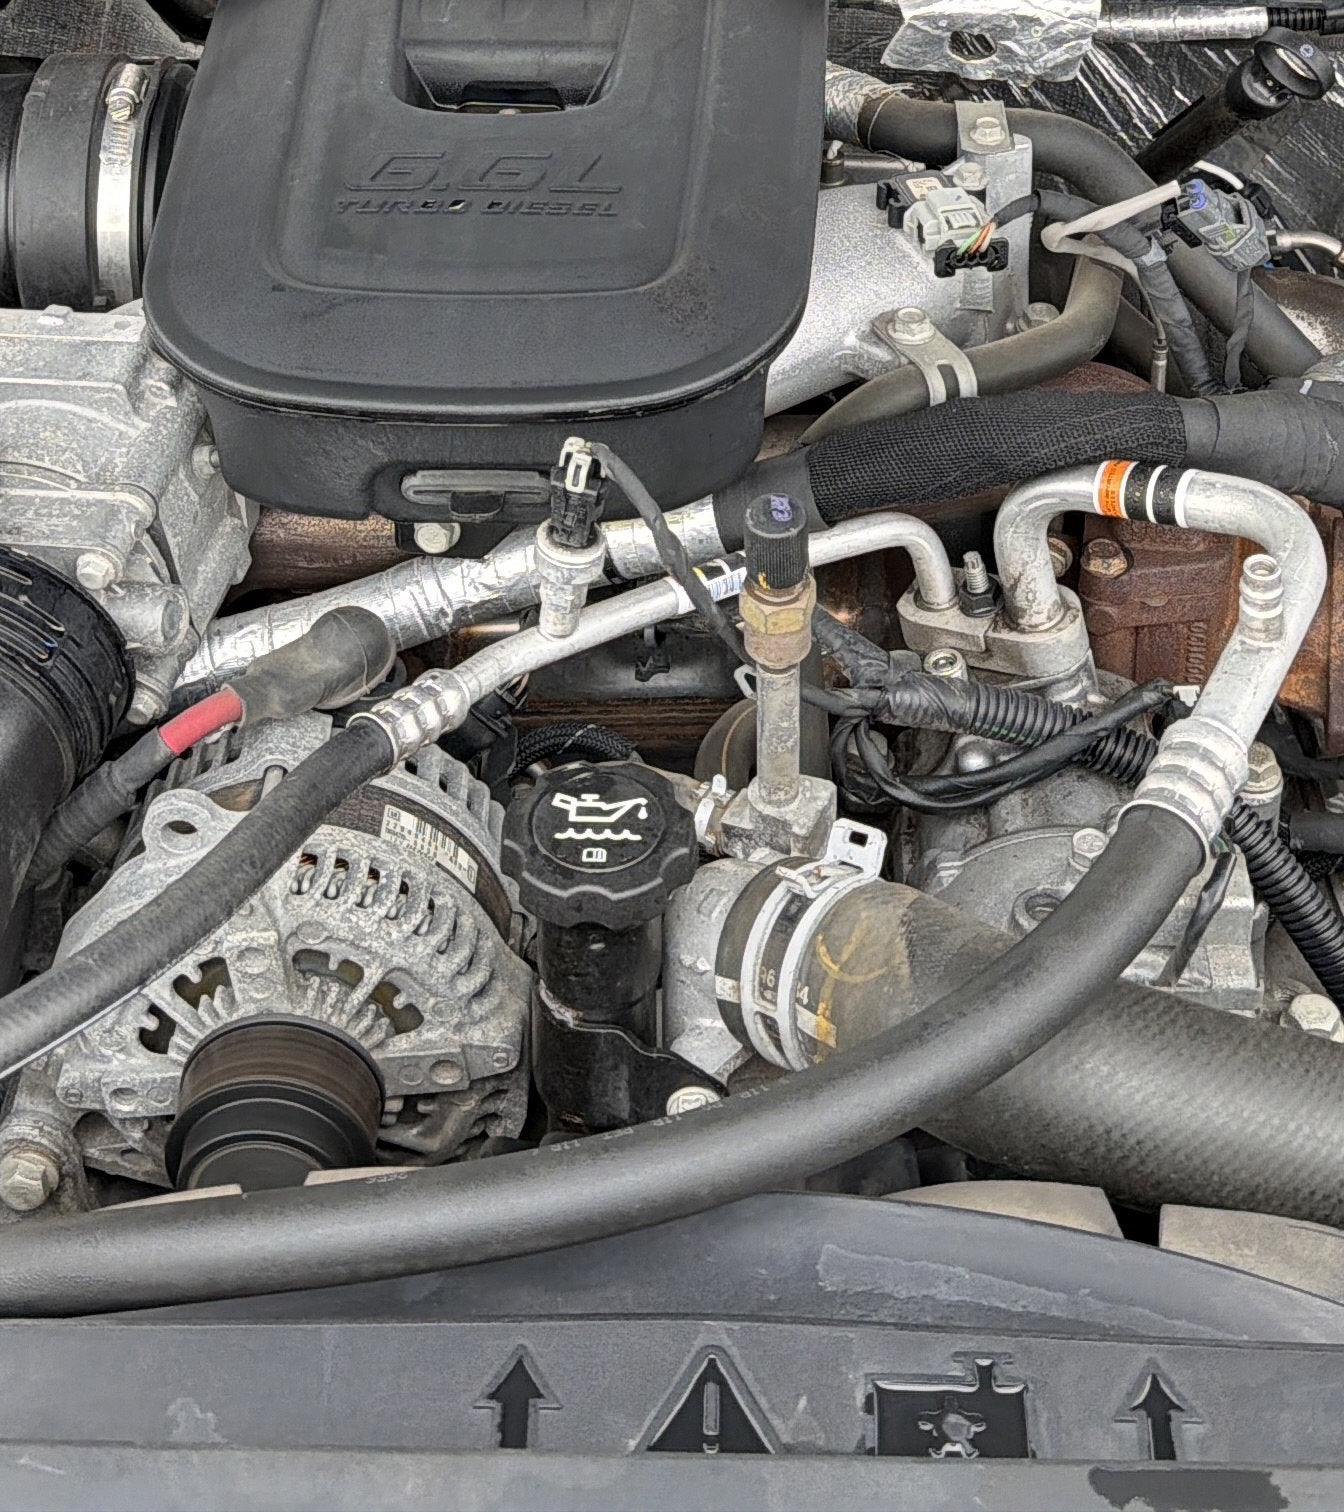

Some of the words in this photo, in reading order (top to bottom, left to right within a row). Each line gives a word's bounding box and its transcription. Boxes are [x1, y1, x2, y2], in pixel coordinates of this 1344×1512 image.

[344, 150, 623, 194] 6.6L
[337, 198, 471, 217] TURBO
[479, 199, 619, 218] DIESEL
